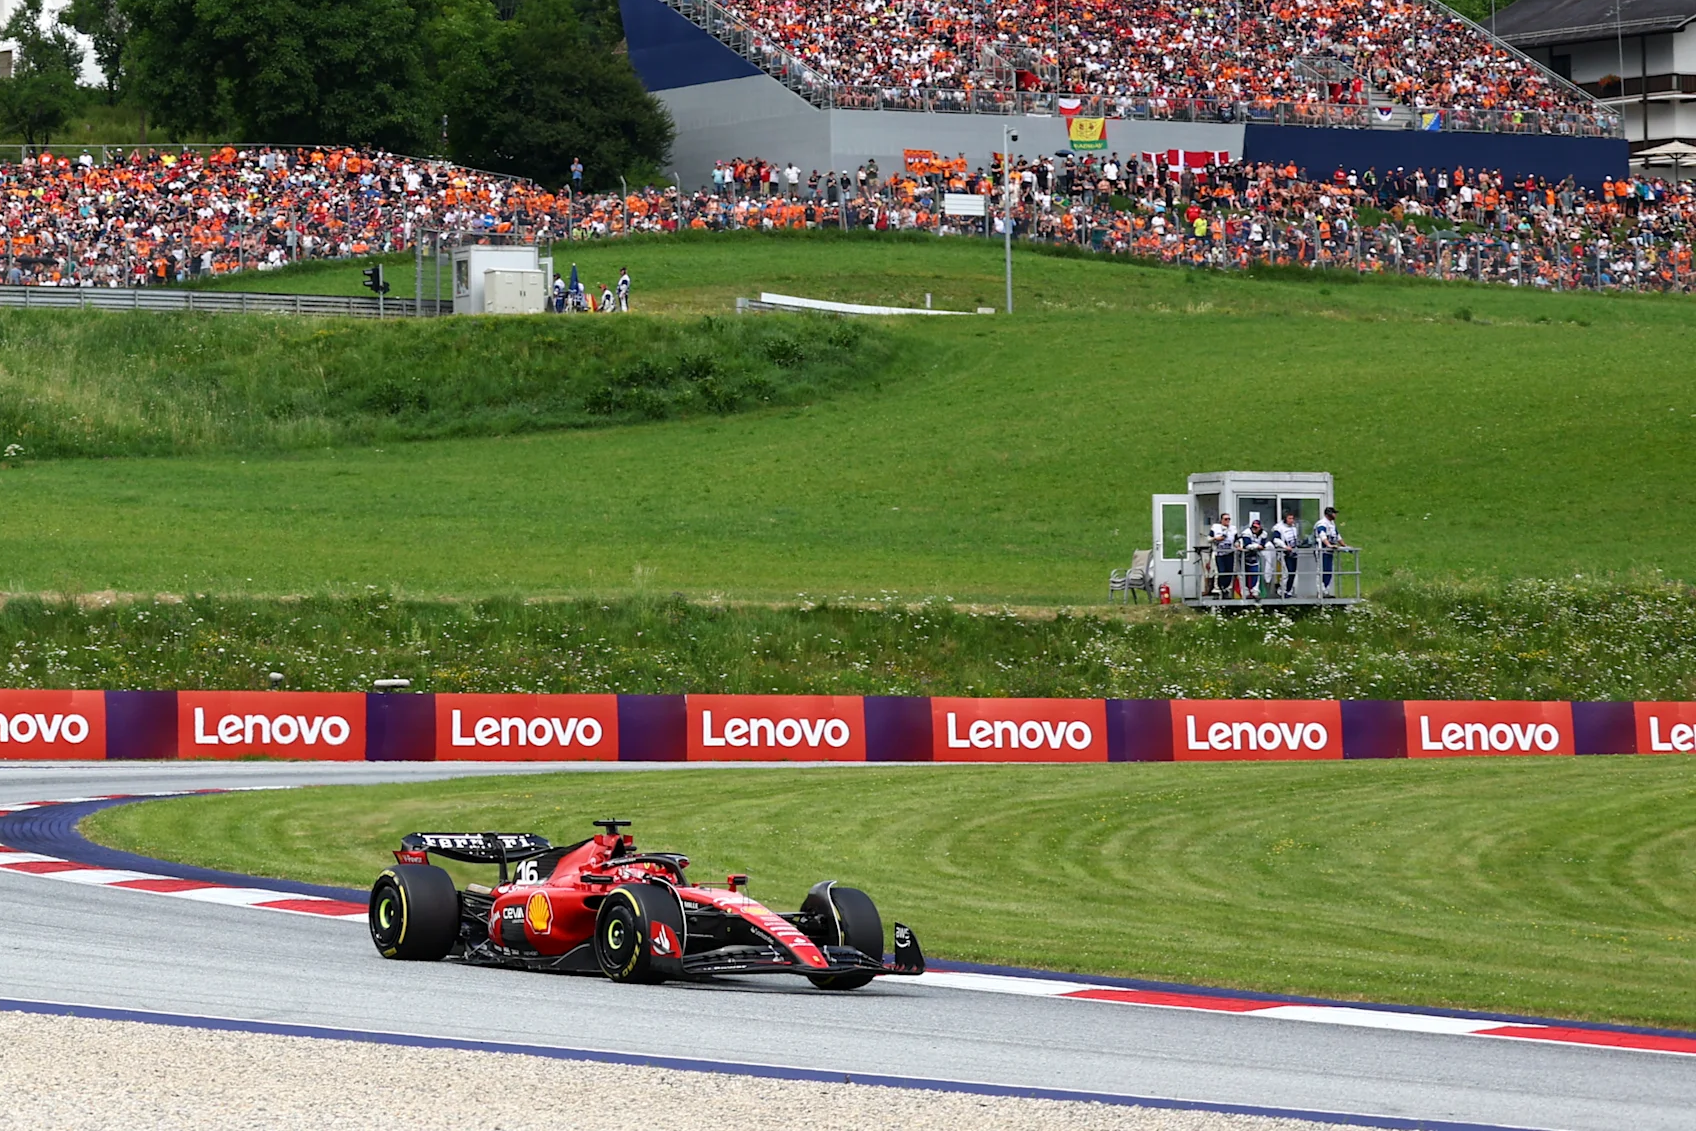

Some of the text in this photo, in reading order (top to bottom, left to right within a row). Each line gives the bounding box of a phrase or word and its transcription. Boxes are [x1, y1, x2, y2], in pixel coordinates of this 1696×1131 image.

[195, 708, 349, 745] Lenovo
[453, 710, 602, 746] Lenovo
[703, 711, 849, 747] Lenovo
[947, 713, 1091, 749] Lenovo
[1187, 716, 1327, 750] Lenovo
[1421, 716, 1559, 750] Lenovo
[1650, 717, 1696, 751] Le
[516, 860, 538, 885] 16
